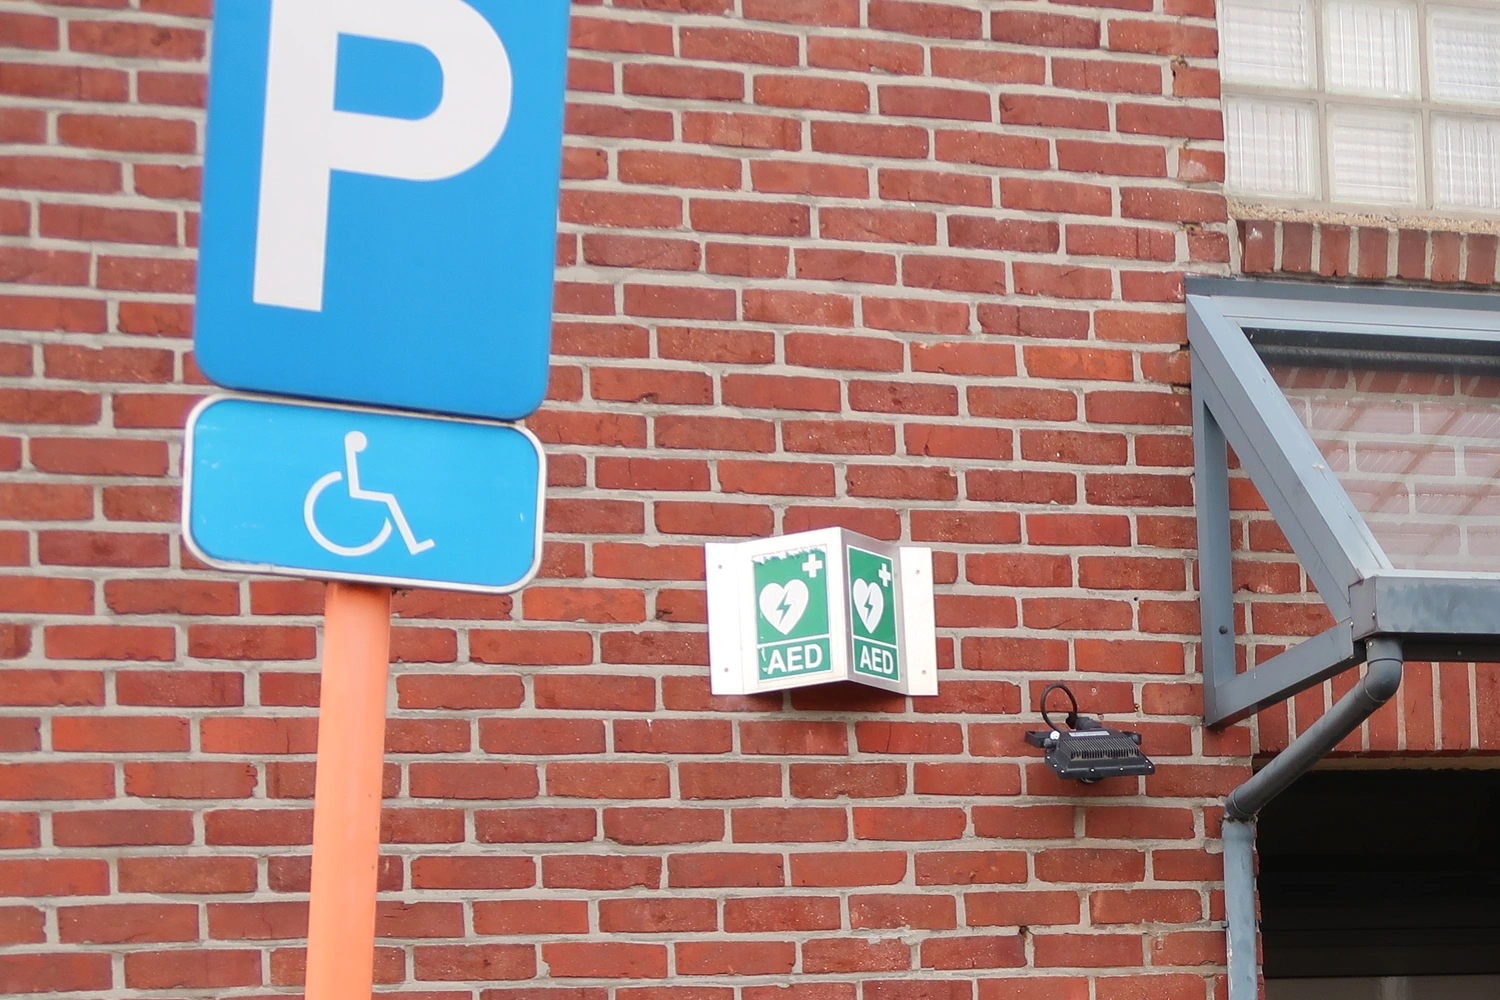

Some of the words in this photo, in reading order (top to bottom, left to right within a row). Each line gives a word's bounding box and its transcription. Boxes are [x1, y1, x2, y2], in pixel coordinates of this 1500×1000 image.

[253, 0, 512, 312] P
[767, 644, 823, 675] AED
[860, 645, 894, 675] AED
